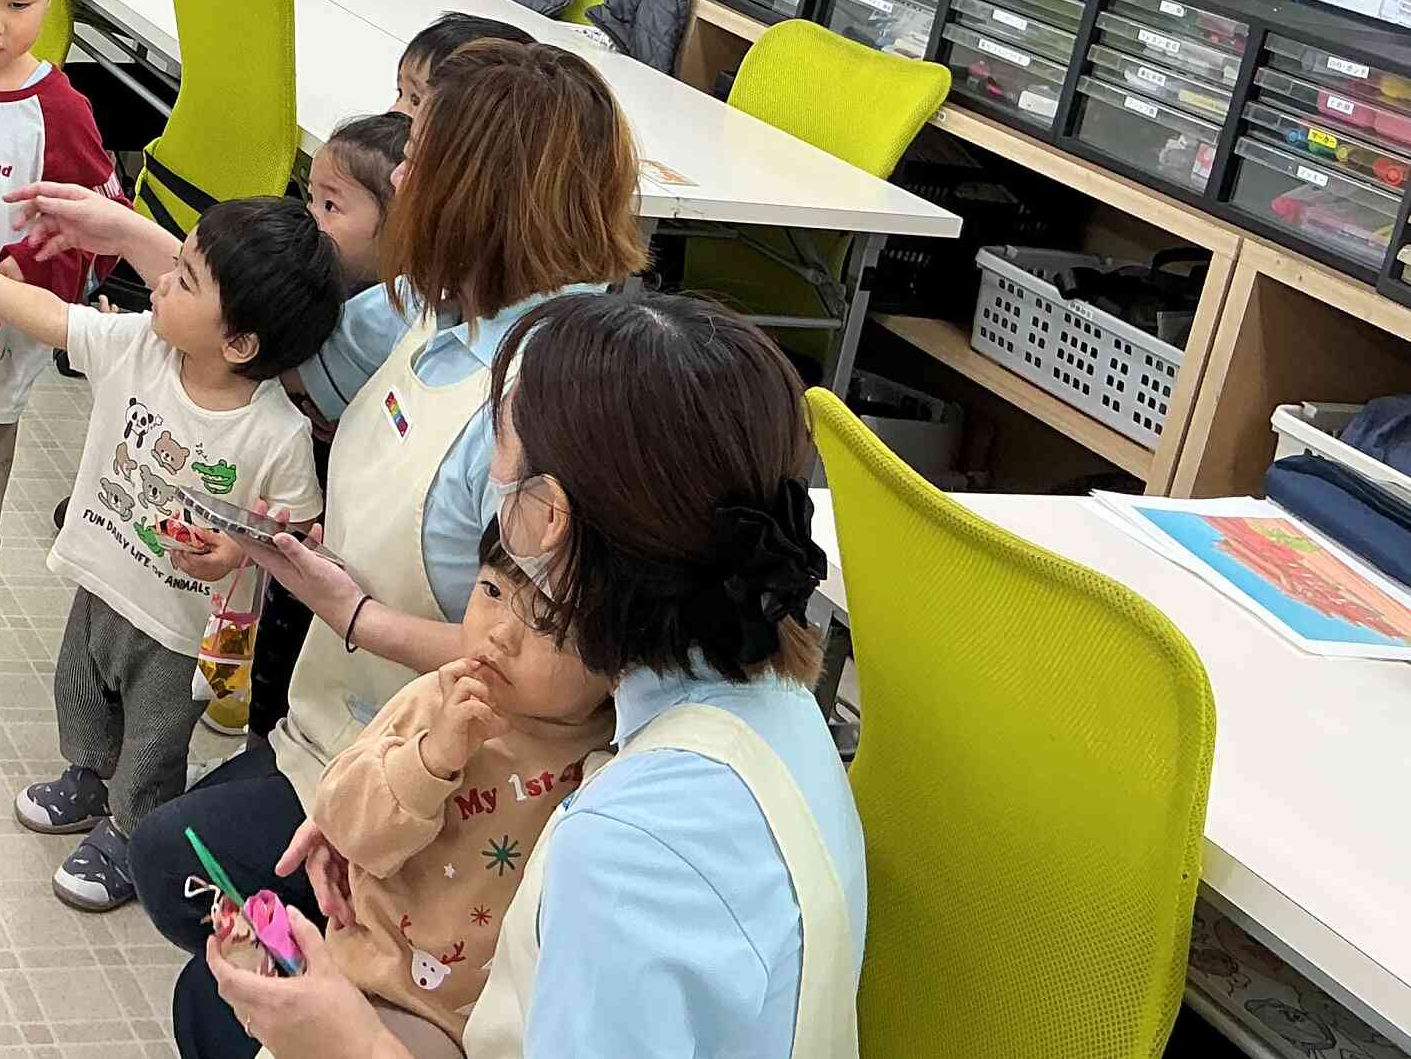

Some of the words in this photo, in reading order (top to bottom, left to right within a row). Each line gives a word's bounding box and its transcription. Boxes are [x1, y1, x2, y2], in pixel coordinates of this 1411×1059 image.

[83, 509, 105, 527] FUN
[107, 521, 129, 549] DAILY
[131, 546, 151, 567] LIFE
[165, 576, 210, 596] ANIMALS
[454, 788, 497, 821] My
[508, 770, 555, 802] 1st
